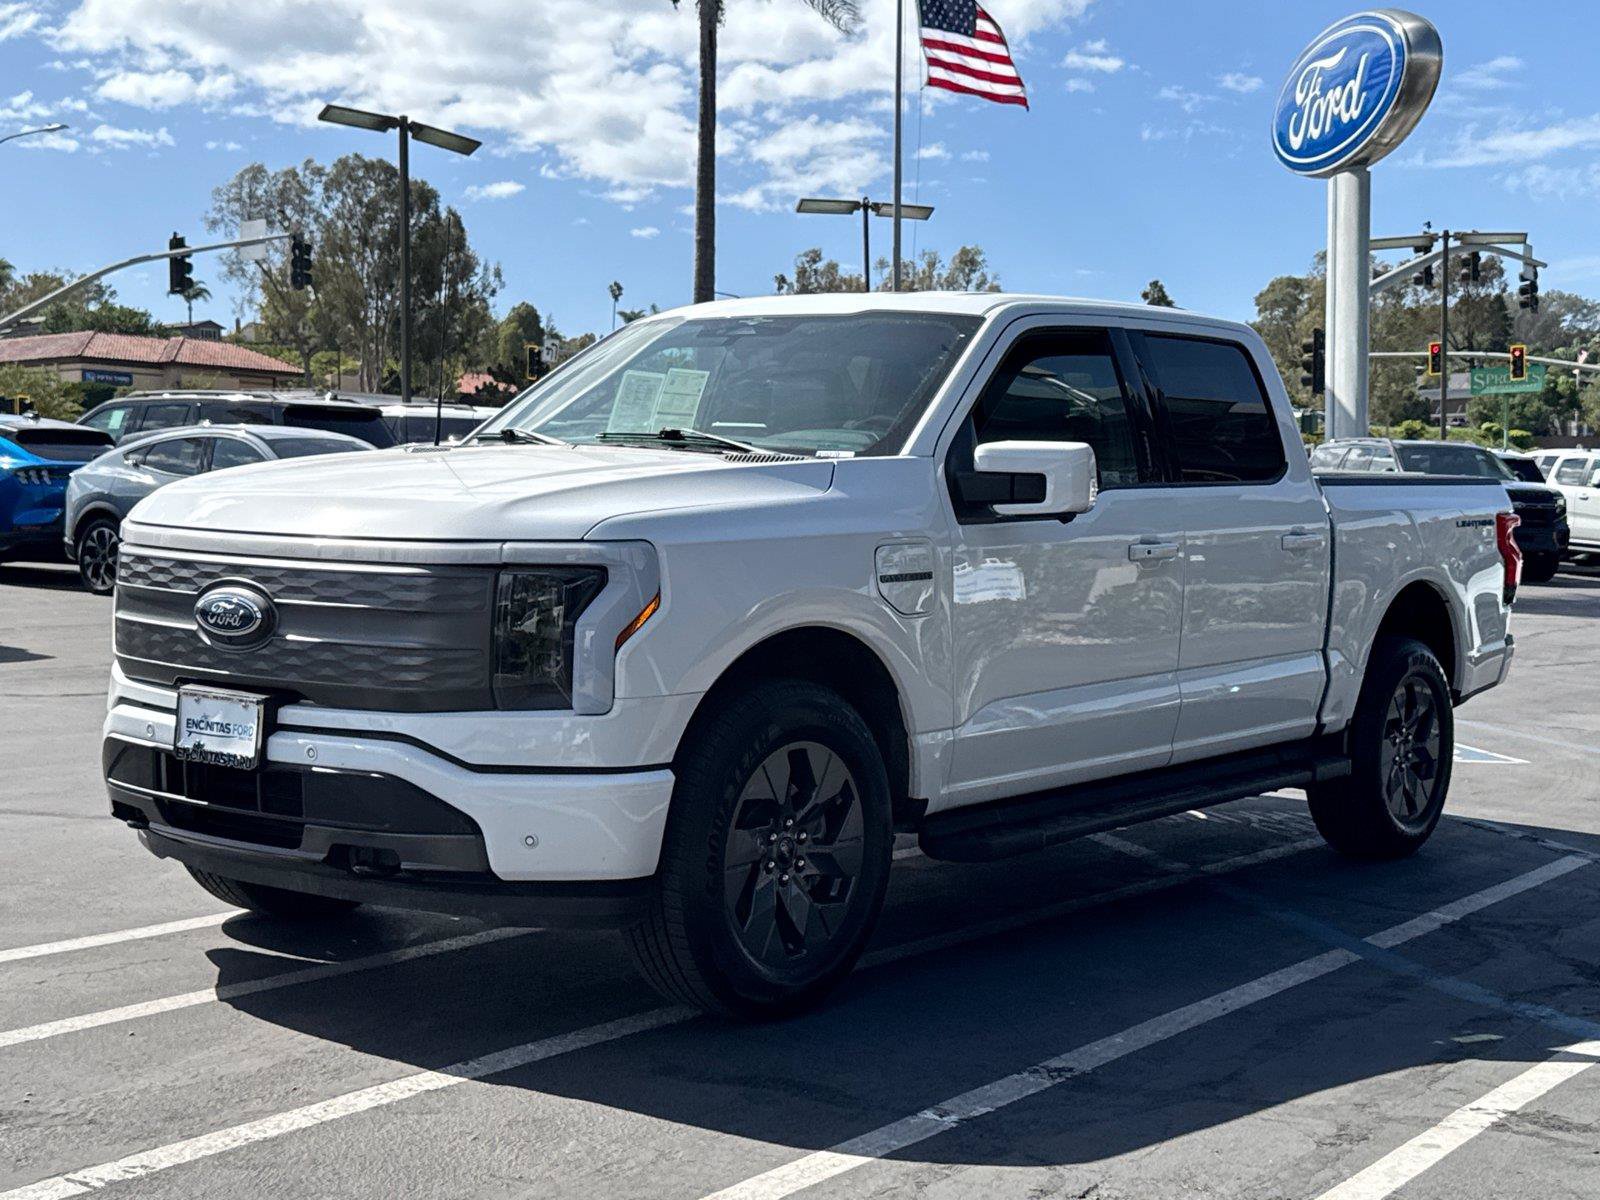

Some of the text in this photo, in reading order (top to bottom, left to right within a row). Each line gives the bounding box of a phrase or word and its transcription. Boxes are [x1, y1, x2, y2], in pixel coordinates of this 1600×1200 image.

[1289, 47, 1368, 150] Ford
[207, 601, 244, 627] Ford
[186, 718, 254, 737] ENCINITAS FORD
